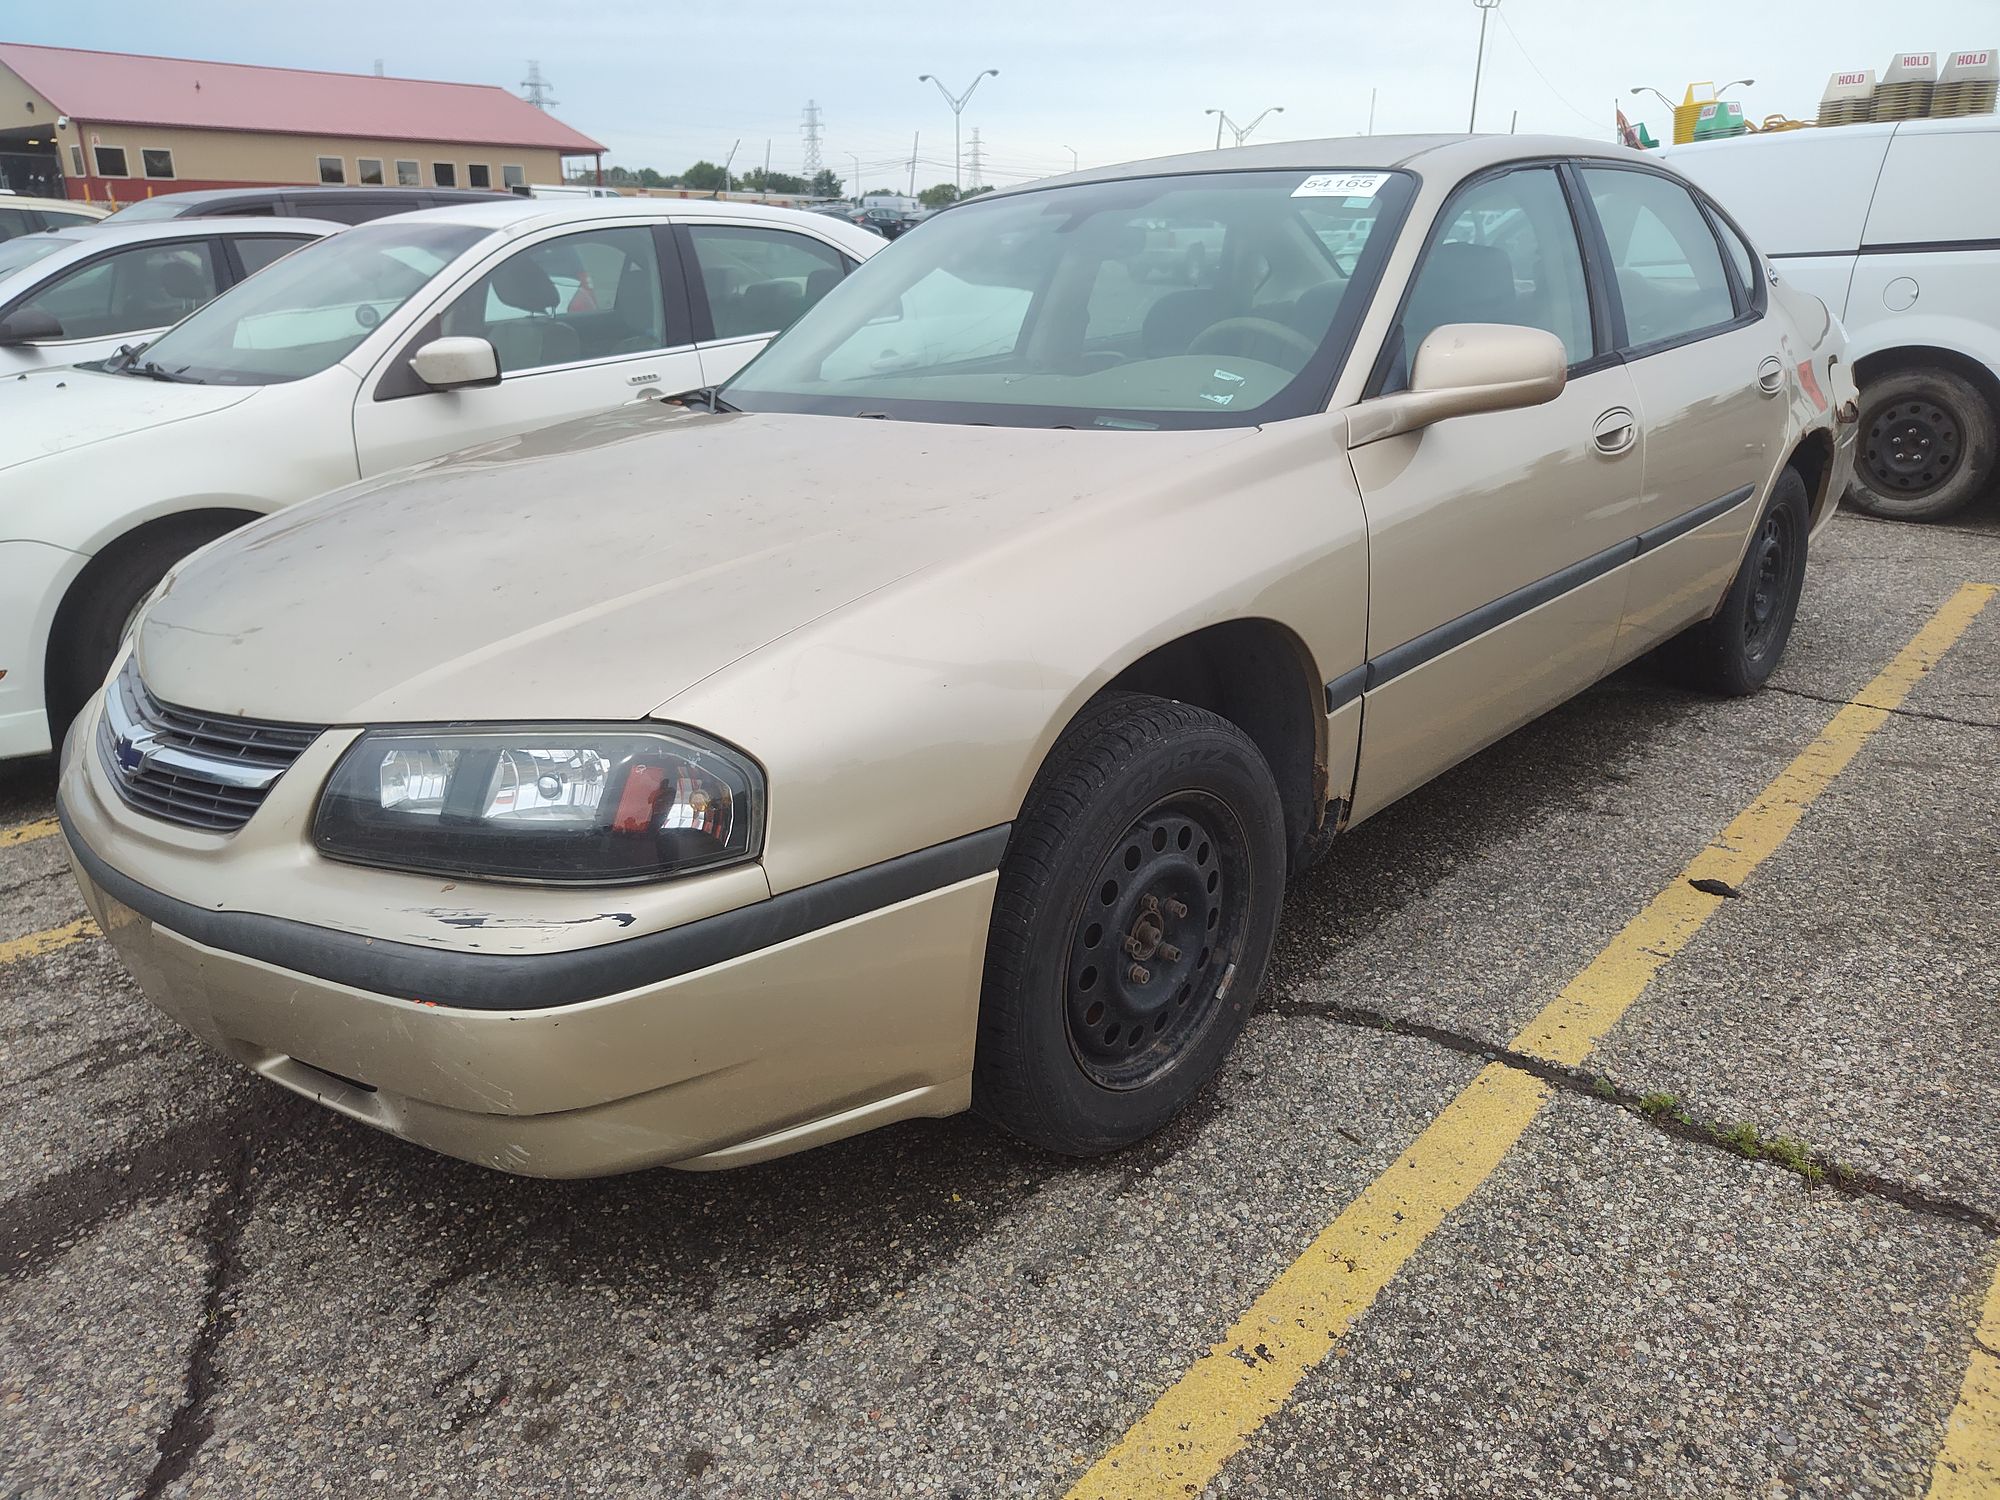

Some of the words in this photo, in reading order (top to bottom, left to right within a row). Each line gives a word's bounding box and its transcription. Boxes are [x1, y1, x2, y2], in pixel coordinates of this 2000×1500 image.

[1903, 56, 1929, 67] HOLD
[1957, 54, 1986, 66] HOLD
[1838, 73, 1865, 86] HOLD
[1304, 179, 1375, 189] 54165
